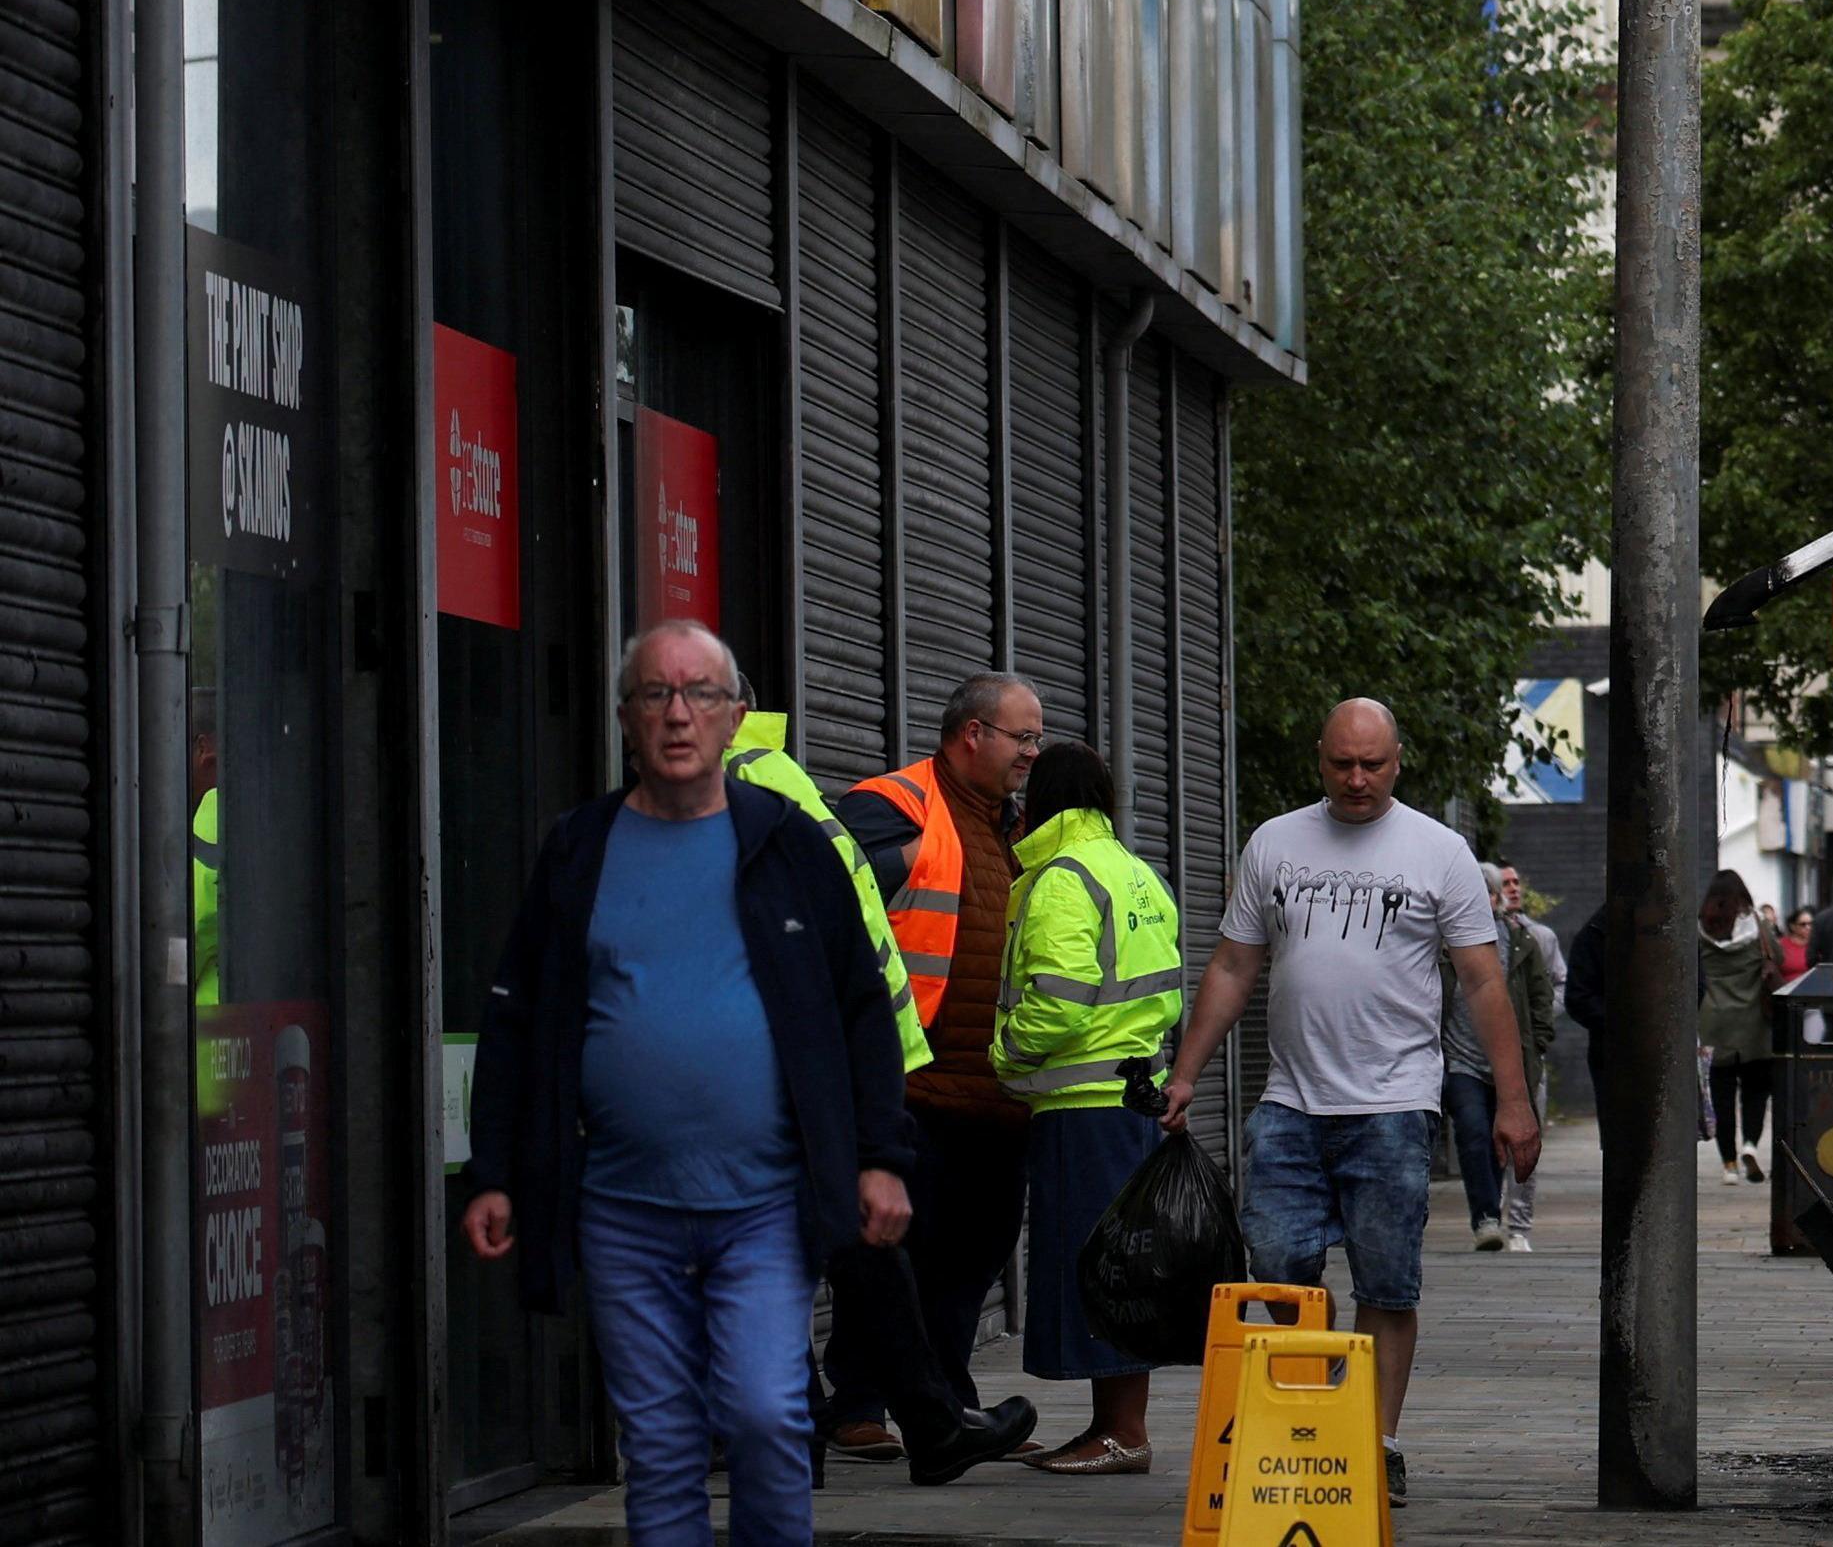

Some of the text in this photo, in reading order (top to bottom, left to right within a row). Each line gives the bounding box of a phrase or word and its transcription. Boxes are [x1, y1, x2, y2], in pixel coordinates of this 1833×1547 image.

[205, 270, 304, 410] THE PAINT SHOP
[238, 421, 291, 543] SKAINOS
[461, 430, 501, 520] restore
[205, 1140, 261, 1196] DECORATORS
[205, 1206, 262, 1308] CHOICE
[1252, 1486, 1352, 1505] WET FLOOR
[1258, 1456, 1348, 1475] CAUTION
